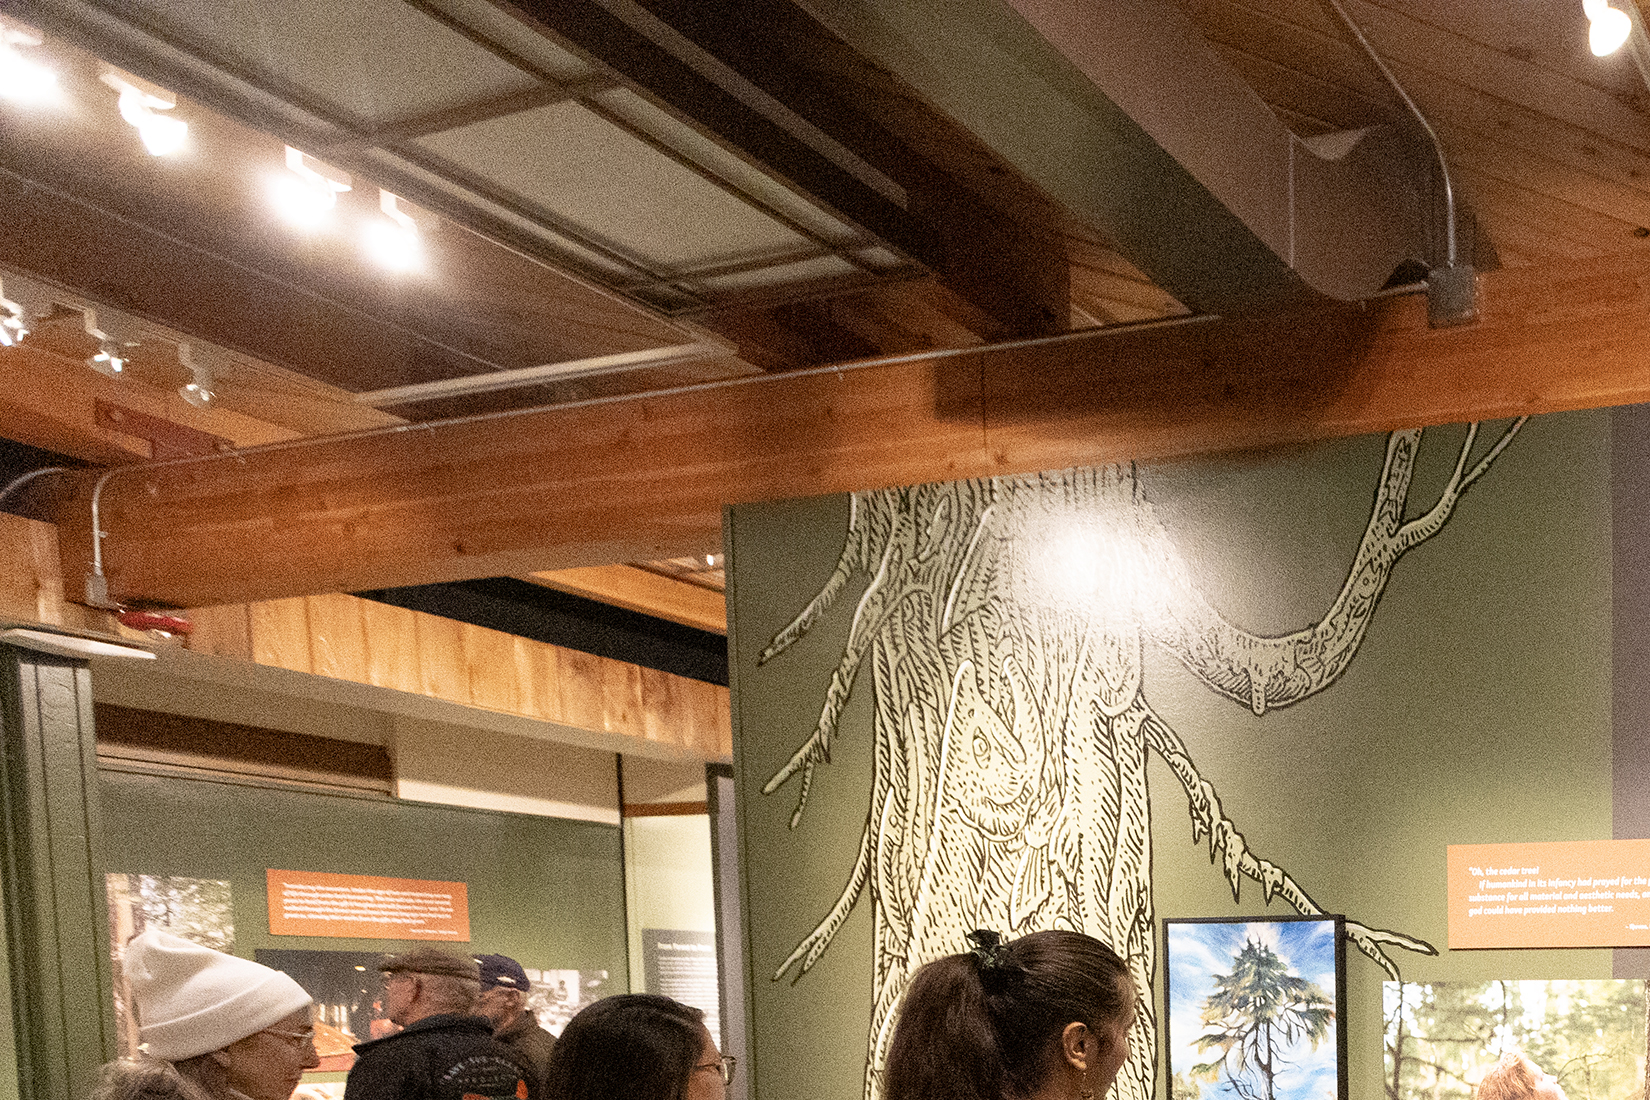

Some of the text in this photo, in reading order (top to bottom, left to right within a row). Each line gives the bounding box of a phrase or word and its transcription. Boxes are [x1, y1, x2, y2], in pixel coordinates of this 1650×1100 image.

[1485, 866, 1498, 875] the
[1499, 866, 1520, 875] cedar
[1521, 866, 1539, 875] tree!
[1486, 879, 1527, 889] humankind
[1528, 879, 1536, 888] in
[1537, 879, 1547, 888] its
[1548, 877, 1576, 889] infancy
[1577, 877, 1592, 886] had
[1592, 876, 1620, 888] prayed
[1620, 875, 1633, 887] for
[1634, 875, 1647, 885] the
[1468, 893, 1506, 902] substance
[1506, 892, 1518, 903] for
[1519, 891, 1529, 901] all
[1529, 891, 1562, 901] material
[1563, 890, 1578, 900] and
[1578, 890, 1614, 900] aesthetic
[1615, 889, 1640, 900] needs,
[1468, 903, 1614, 917] god could have provided nothing better.
